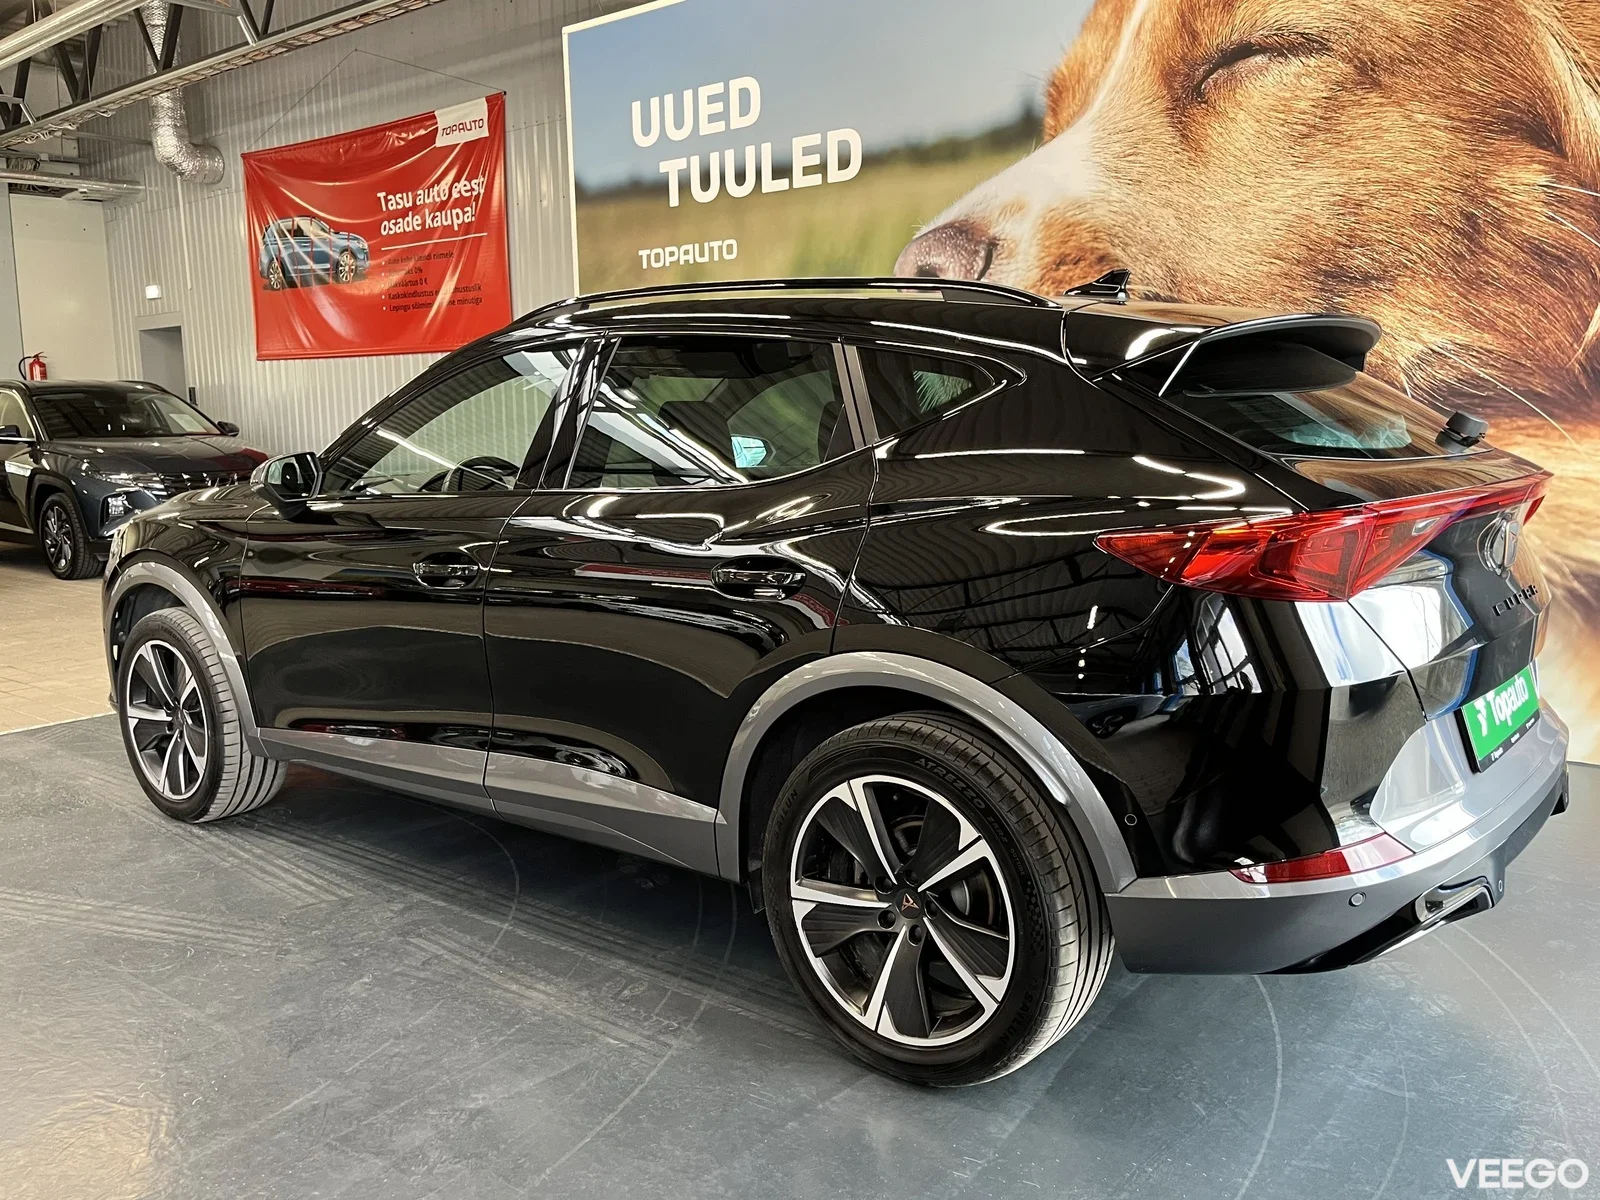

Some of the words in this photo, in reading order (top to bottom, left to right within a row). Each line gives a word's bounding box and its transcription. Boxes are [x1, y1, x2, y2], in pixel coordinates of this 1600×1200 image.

[441, 118, 485, 136] TOPAUTO
[631, 76, 761, 147] UUED
[659, 128, 863, 208] TUULED
[377, 191, 413, 212] Tasu
[415, 184, 449, 206] auto
[452, 175, 485, 199] eest
[380, 211, 422, 235] osade
[425, 201, 476, 231] kaupa!
[638, 239, 738, 270] TOPAUTO
[390, 304, 411, 312] Lepingu
[1486, 674, 1529, 726] Topauto
[915, 758, 986, 809] ATREZZO
